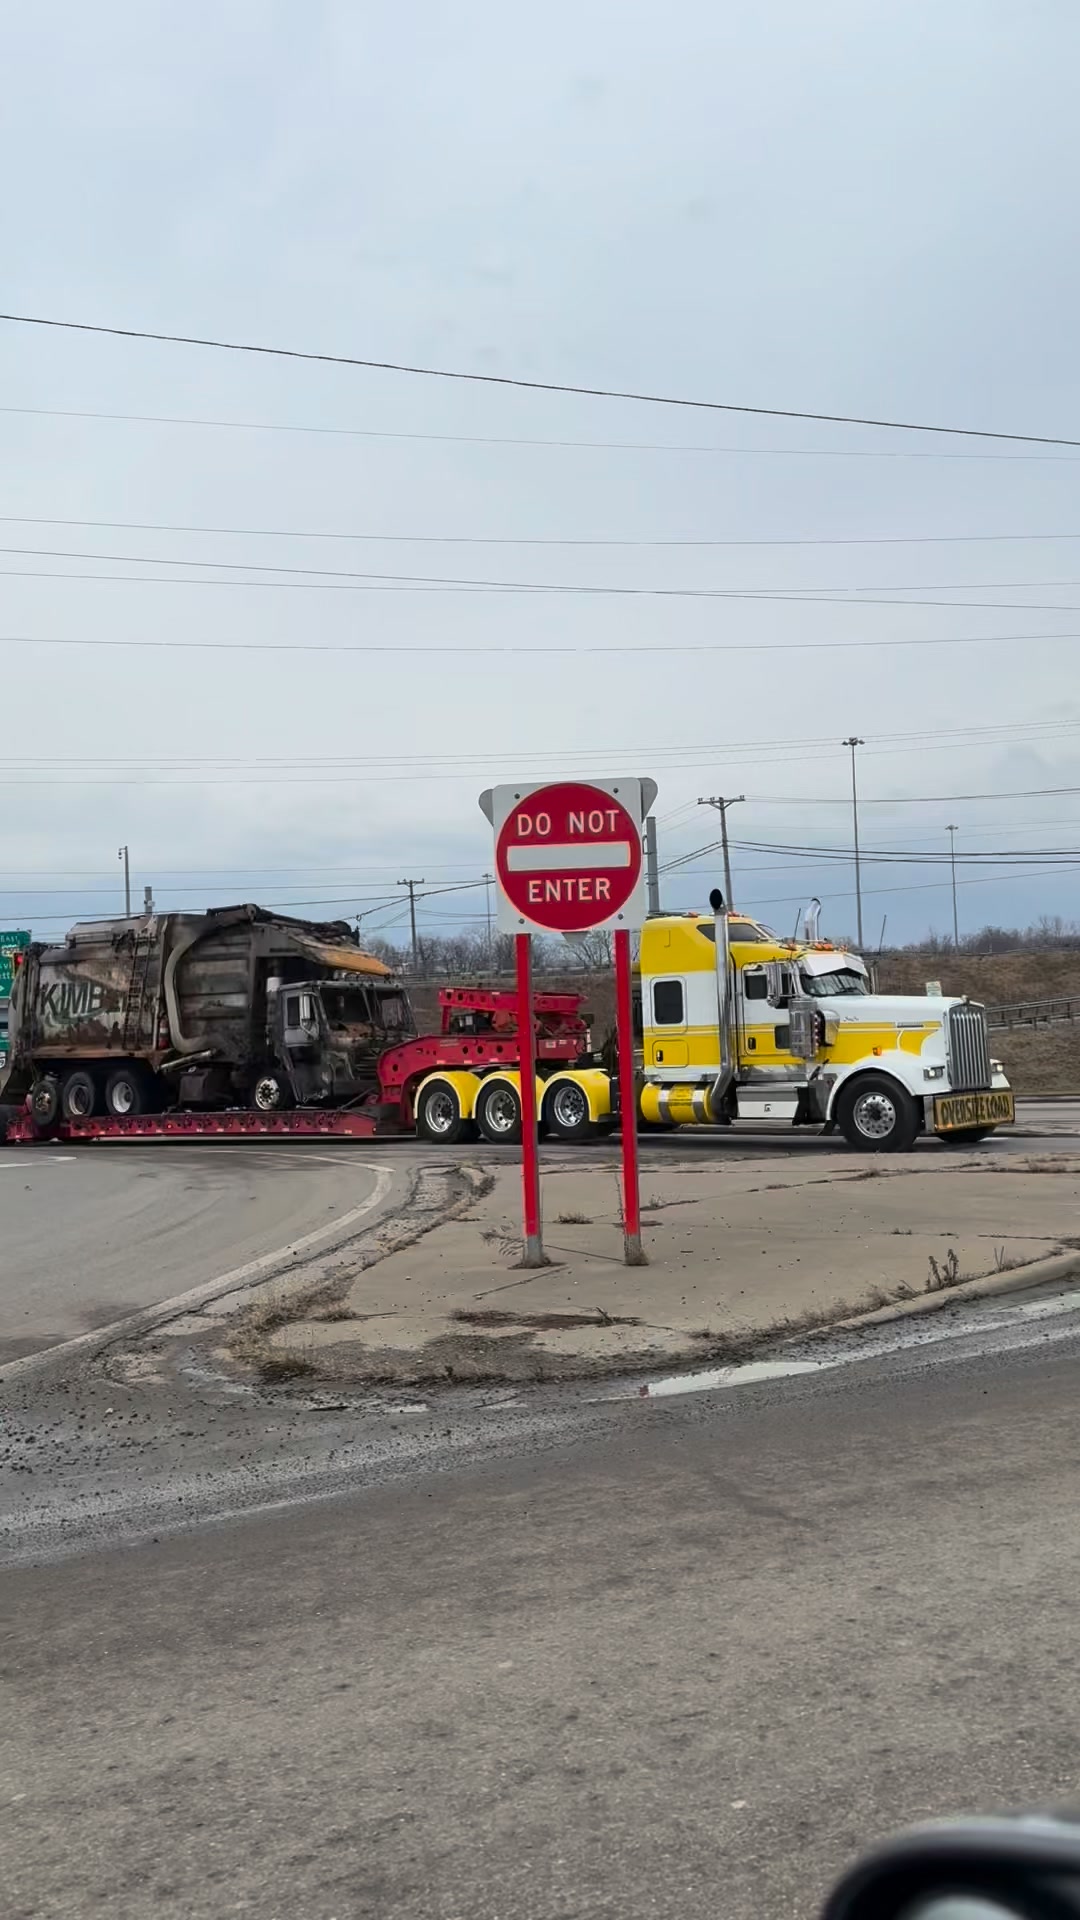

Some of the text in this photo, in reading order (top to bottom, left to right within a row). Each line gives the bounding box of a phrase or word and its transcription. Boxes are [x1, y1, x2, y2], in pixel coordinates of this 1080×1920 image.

[517, 810, 620, 836] DO NOT
[528, 878, 611, 903] ENTER
[41, 982, 134, 1015] KIMB
[941, 1095, 1010, 1125] OVERSIZE LOAD
